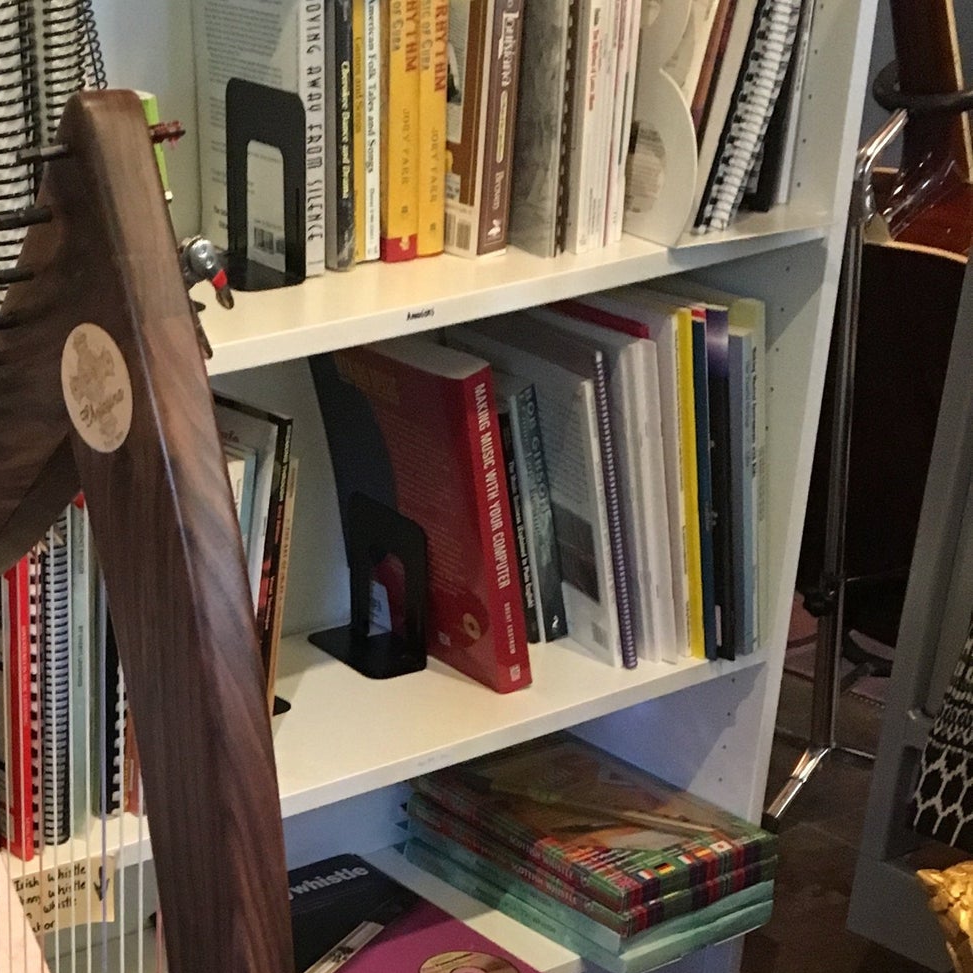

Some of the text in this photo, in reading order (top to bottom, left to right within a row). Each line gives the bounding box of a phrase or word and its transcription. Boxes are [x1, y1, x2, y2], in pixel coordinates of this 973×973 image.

[498, 10, 518, 86] Louisiana
[366, 54, 378, 79] Folk
[306, 66, 323, 112] AWAY
[366, 83, 376, 111] Tales
[366, 115, 376, 135] and
[400, 107, 412, 142] JORY
[306, 123, 324, 169] FROM
[364, 139, 377, 173] Songs
[429, 128, 439, 160] JORY
[492, 171, 504, 209] Brown
[307, 179, 324, 240] SILENCE
[471, 383, 492, 430] MAKING
[477, 431, 497, 468] MUSIC
[482, 468, 500, 499] WITH
[485, 500, 504, 531] YOUR
[489, 531, 512, 589] COMPUTER
[14, 877, 39, 892] Irish
